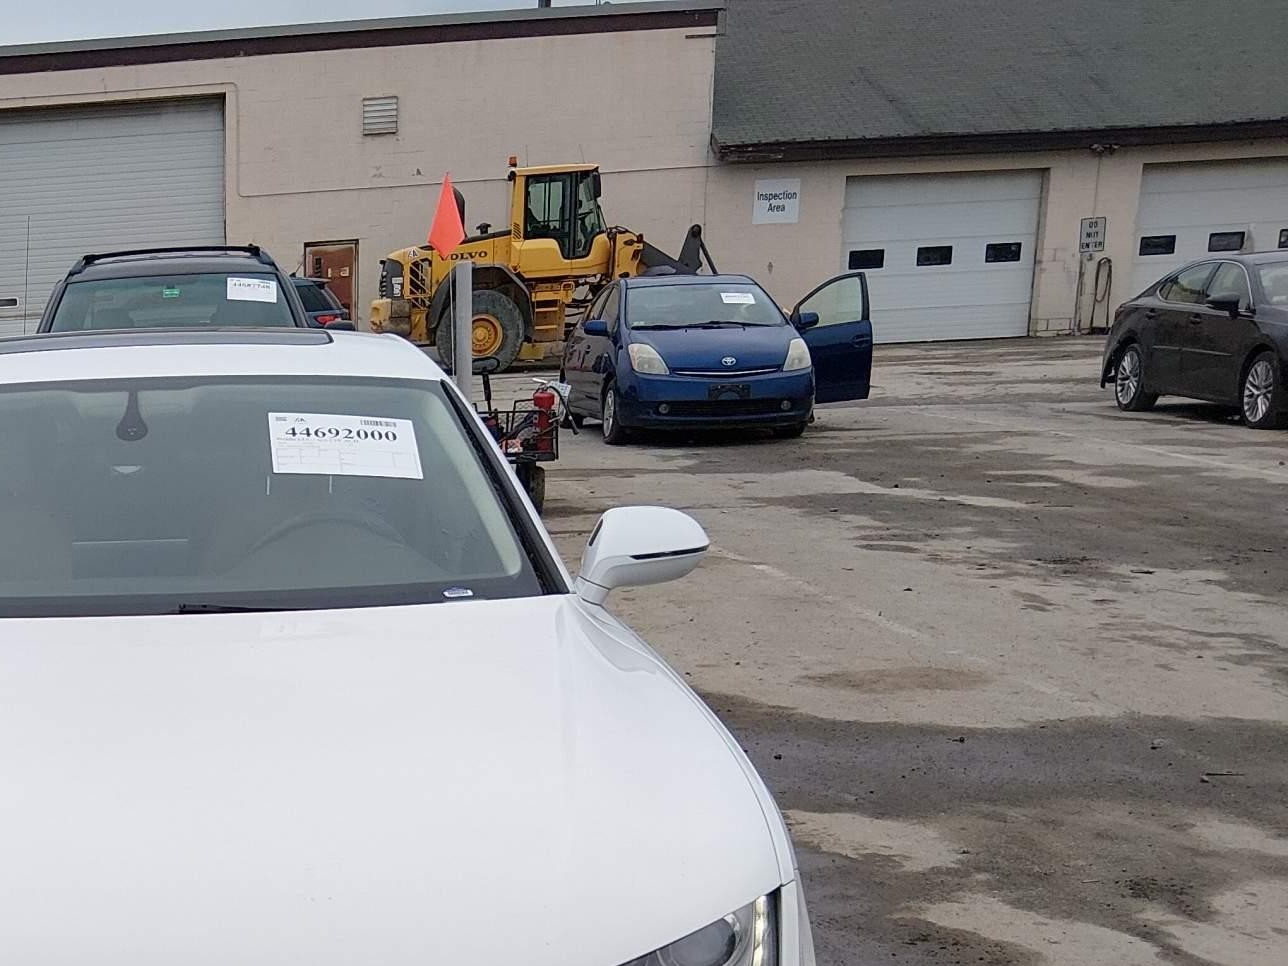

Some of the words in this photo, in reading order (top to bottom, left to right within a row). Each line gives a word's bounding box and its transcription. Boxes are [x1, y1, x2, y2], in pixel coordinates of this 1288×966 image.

[757, 190, 798, 202] Inspection
[767, 203, 785, 213] Area
[1088, 220, 1098, 229] DO
[1081, 241, 1103, 250] ENTER
[285, 426, 398, 442] 44692000
